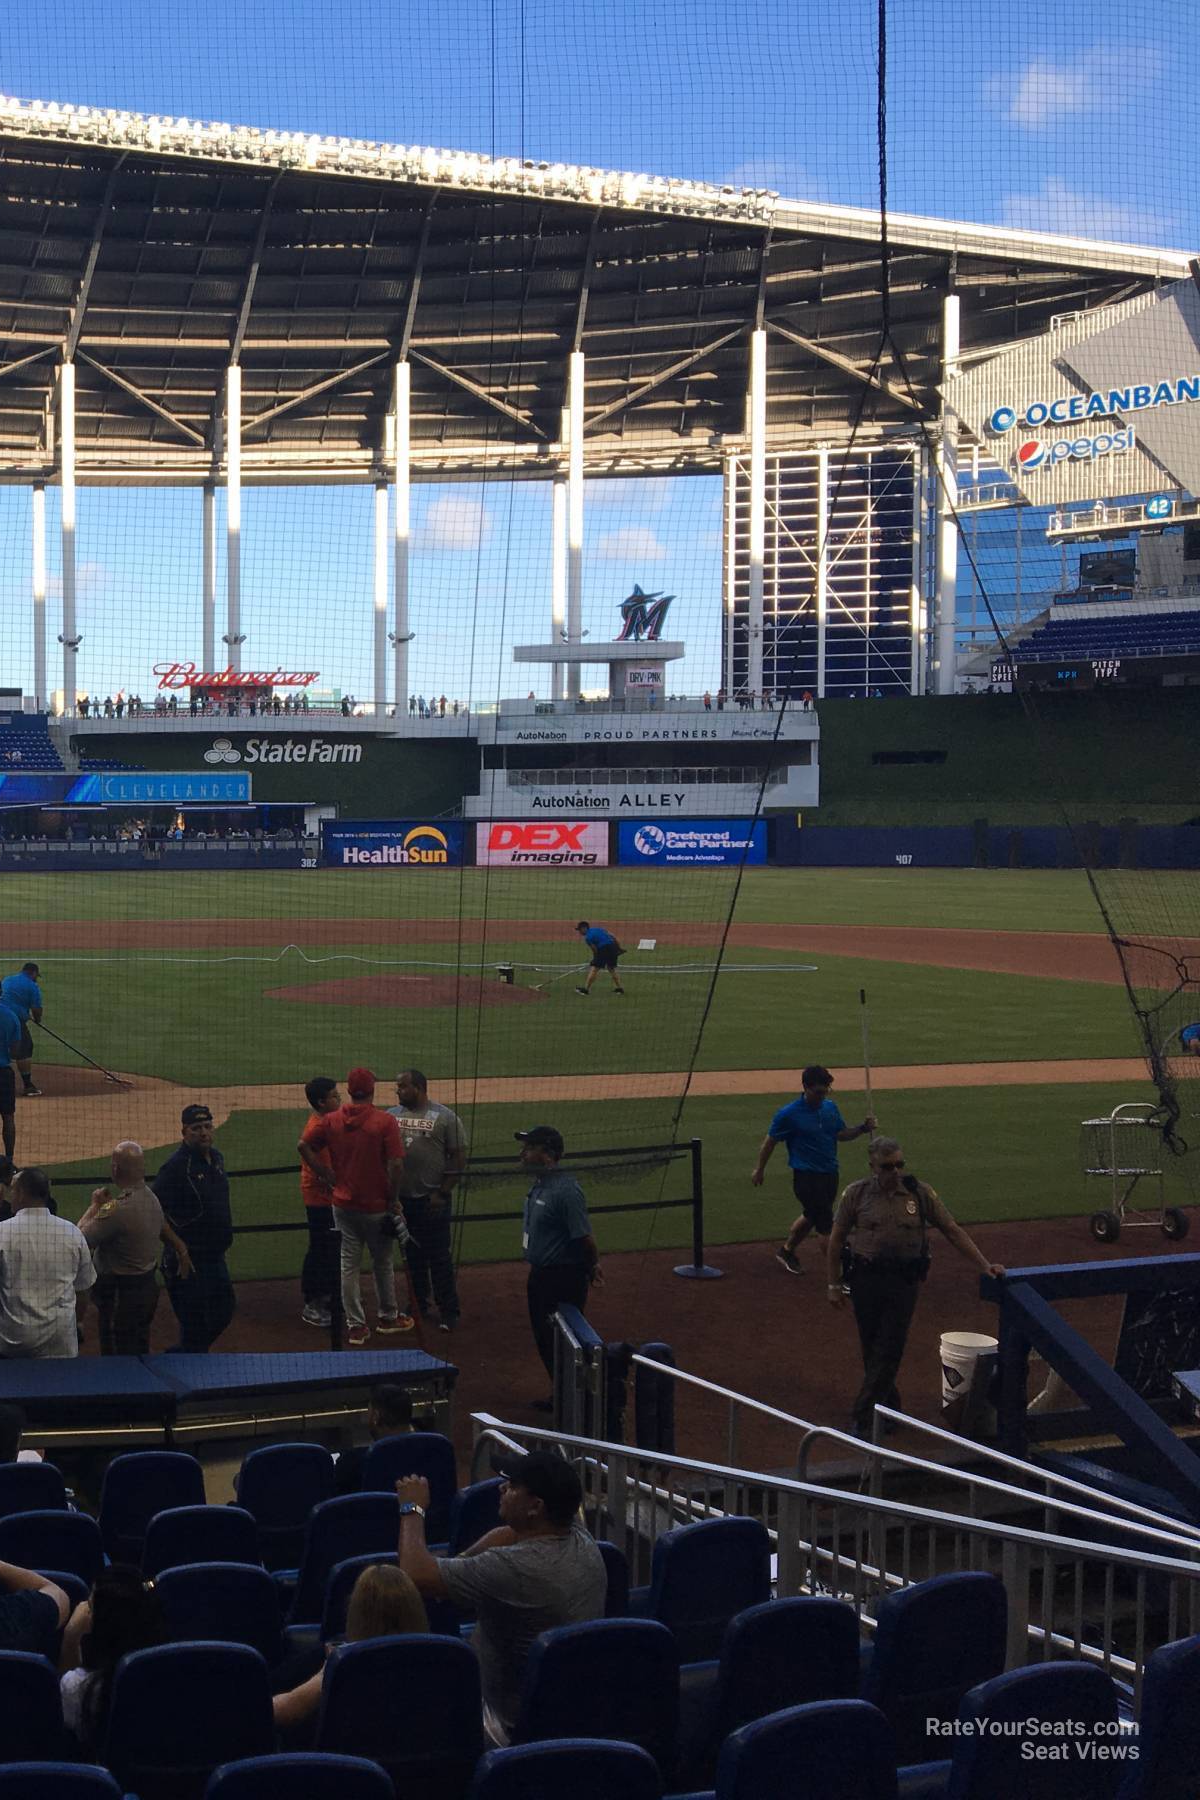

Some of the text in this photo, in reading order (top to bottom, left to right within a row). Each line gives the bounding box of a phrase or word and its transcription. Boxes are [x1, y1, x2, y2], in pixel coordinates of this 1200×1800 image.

[1025, 376, 1200, 427] OCEANBAN
[1050, 425, 1134, 465] pepsi
[1149, 499, 1169, 515] 42
[1092, 660, 1121, 669] PITCH
[152, 661, 321, 690] Budweiser
[1094, 668, 1118, 678] TYPE
[517, 731, 567, 740] AutoNation
[584, 731, 634, 740] PROUD
[643, 729, 717, 739] PARTNERS
[105, 777, 245, 799] CLEVELANDER
[532, 793, 686, 808] AutoNation ALLEY
[489, 824, 588, 850] DEX
[666, 831, 730, 840] Preferred
[666, 840, 755, 848] Care Partners
[343, 845, 447, 864] HealthSun
[511, 849, 598, 866] imaging
[895, 854, 913, 865] 407
[400, 1119, 433, 1130] HILLIES
